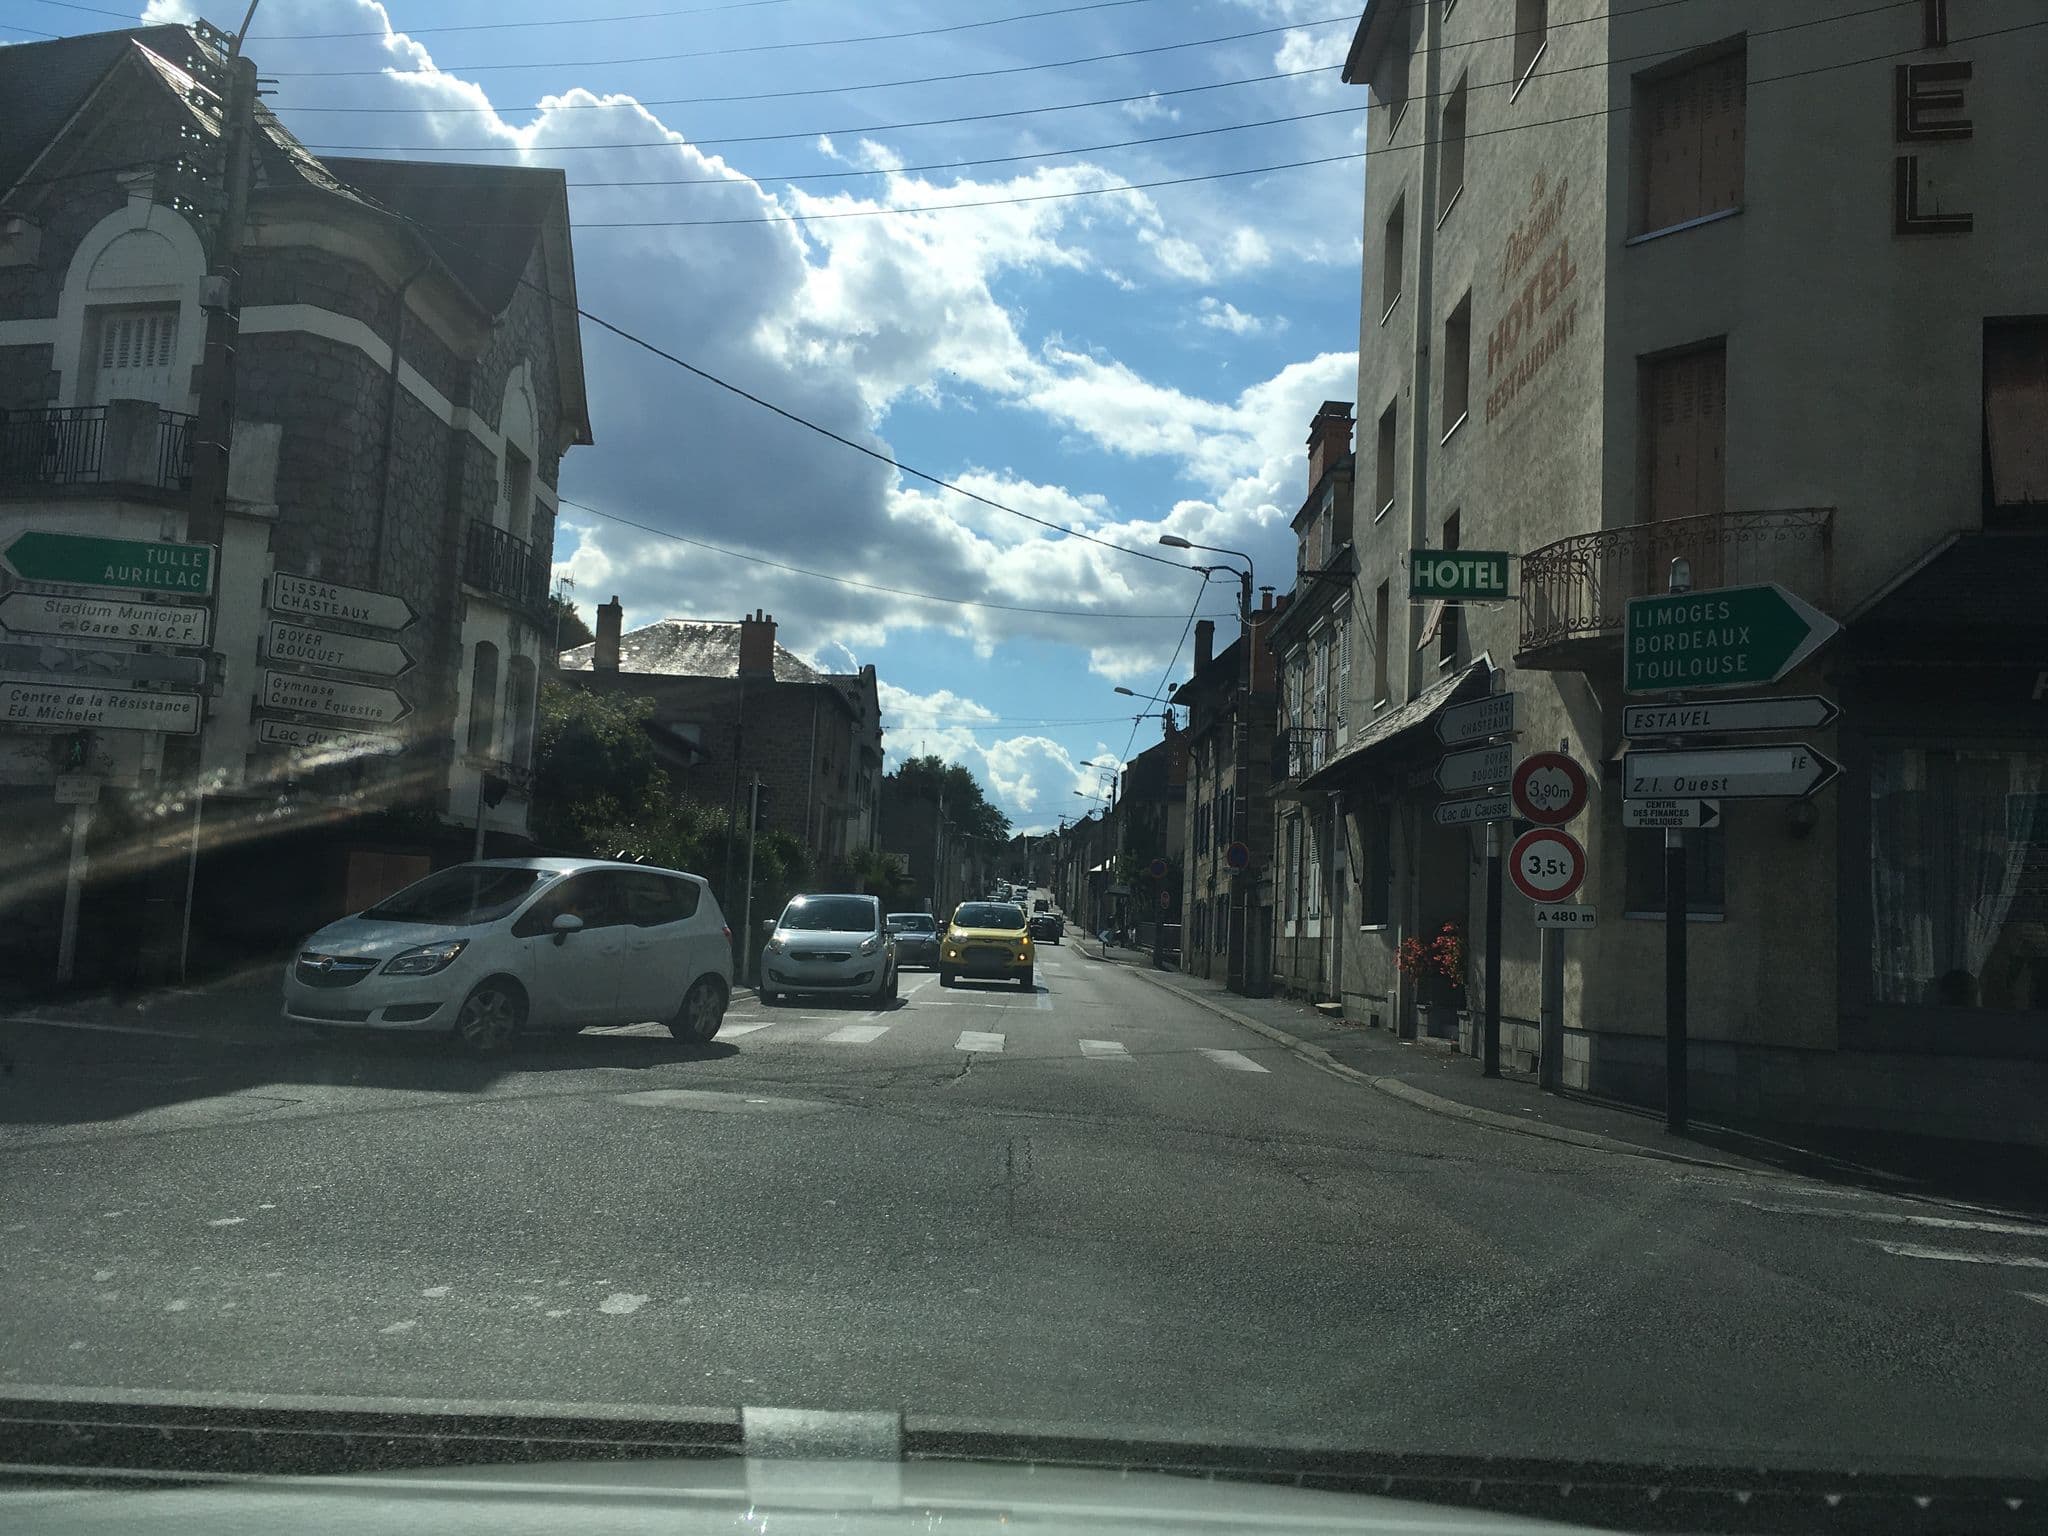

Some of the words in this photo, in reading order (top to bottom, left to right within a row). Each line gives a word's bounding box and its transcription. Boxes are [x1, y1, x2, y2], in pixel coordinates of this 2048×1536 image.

[1488, 238, 1577, 378] HOTEL
[1486, 298, 1577, 425] RESTAURANT
[146, 549, 202, 567] TULLE
[104, 565, 201, 587] AURILLAC
[1414, 560, 1504, 589] HOTEL
[282, 579, 338, 600] LISSAC
[44, 600, 112, 617] Stadium
[118, 606, 198, 624] Municipal
[281, 594, 370, 620] CHASTEAUX
[1635, 601, 1730, 628] LIMOGES
[80, 620, 119, 634] Gare
[129, 624, 197, 640] S.N.C.F.
[278, 629, 322, 646] BOYER
[1635, 626, 1750, 654] BORDEAUX
[276, 643, 345, 664] BOUQUET
[1635, 654, 1748, 679] TOULOUSE
[273, 678, 335, 697] Gymnase
[10, 689, 61, 703] Centre
[67, 691, 84, 706] de
[90, 694, 103, 707] la
[108, 696, 191, 712] Résistance
[271, 692, 318, 708] Centre
[1479, 701, 1510, 718] LISSAC
[8, 704, 29, 718] Ed.
[37, 706, 104, 722] Michelet
[1634, 711, 1711, 729] ESTAVEL
[268, 725, 298, 741] Lac
[1461, 716, 1509, 736] CHASTEAUX
[1633, 777, 1663, 792] Z.I.
[1673, 776, 1728, 792] Ouest
[1442, 808, 1457, 822] Lac
[1460, 806, 1472, 818] du
[1475, 802, 1508, 817] Causse
[1633, 809, 1648, 817] DES
[1650, 809, 1689, 817] FINANCES
[1639, 818, 1683, 826] PUBLIQUES
[1528, 856, 1567, 877] 3,5t
[1537, 911, 1547, 921] A
[1551, 911, 1577, 921] 480
[1582, 913, 1594, 922] m
